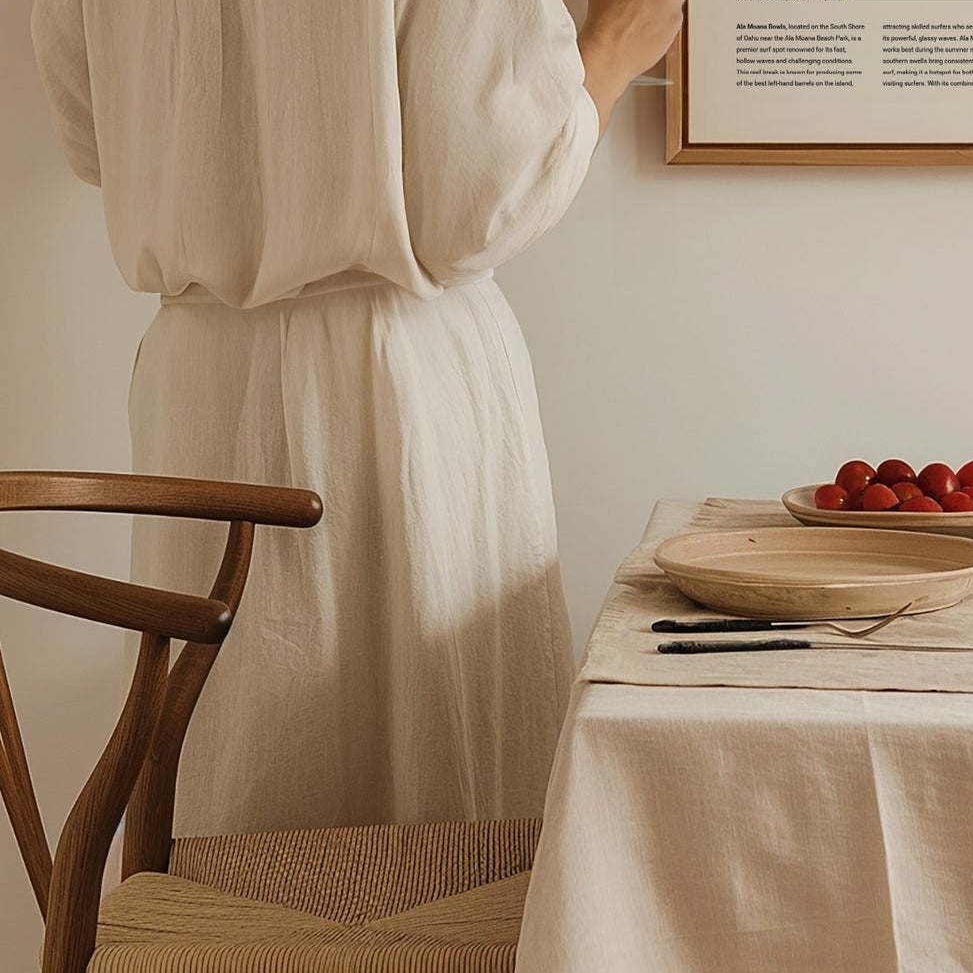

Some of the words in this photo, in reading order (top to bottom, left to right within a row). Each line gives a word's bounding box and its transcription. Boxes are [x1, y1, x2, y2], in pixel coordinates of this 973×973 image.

[918, 35, 938, 43] glassy
[736, 46, 759, 54] premier
[914, 46, 934, 55] during
[787, 58, 821, 66] challenging
[928, 57, 944, 66] bring
[896, 69, 918, 77] making
[736, 79, 743, 87] of
[882, 80, 904, 88] visiting
